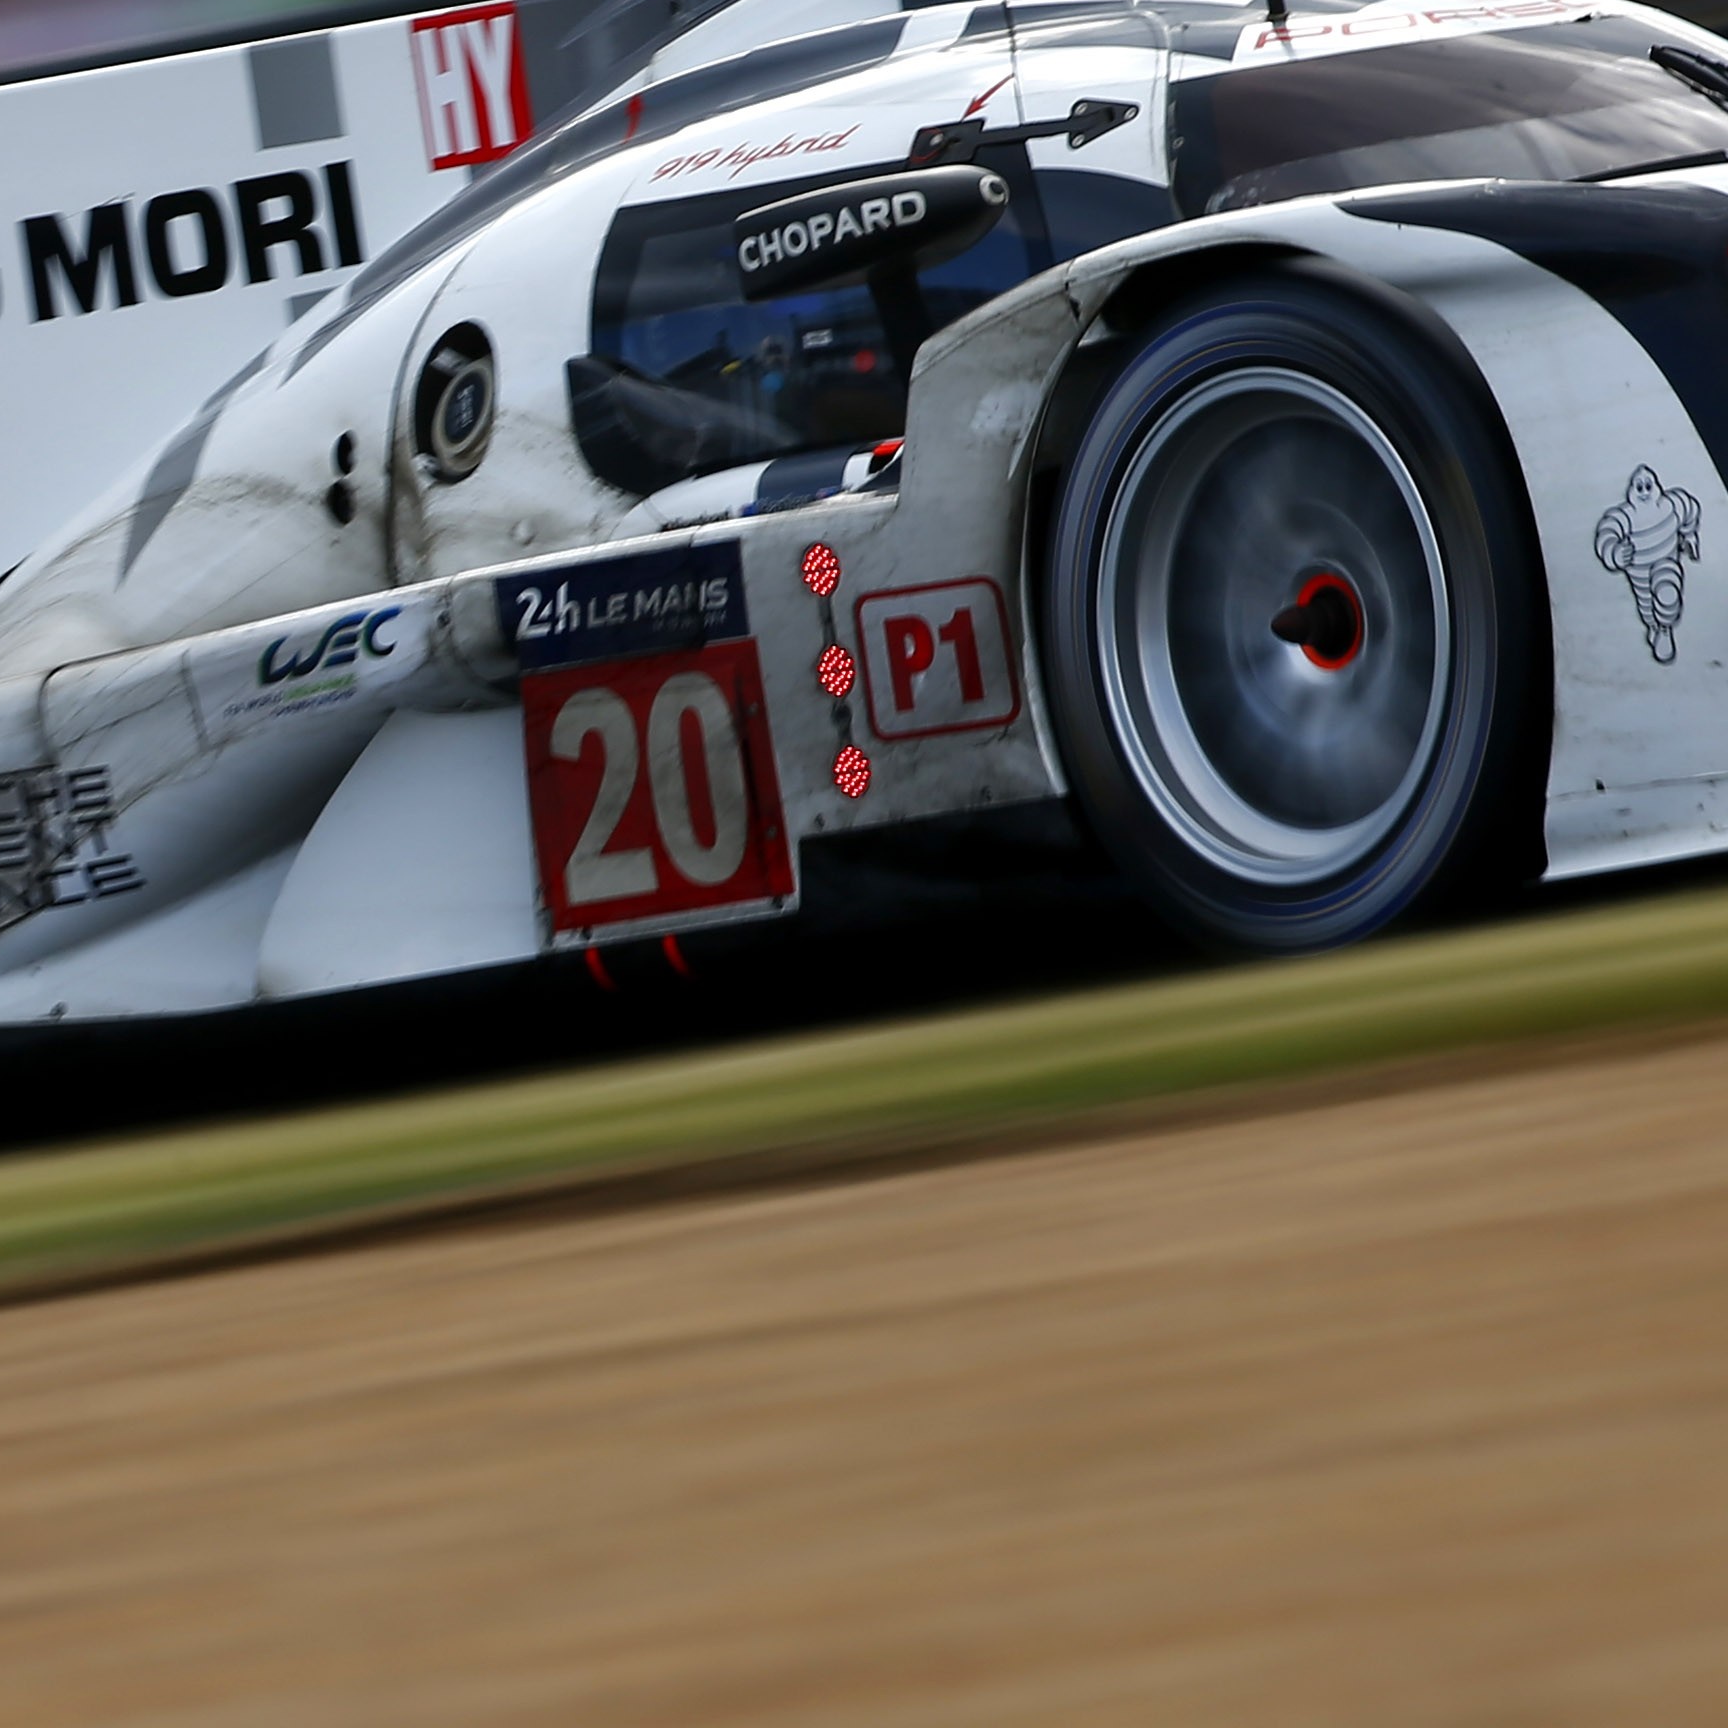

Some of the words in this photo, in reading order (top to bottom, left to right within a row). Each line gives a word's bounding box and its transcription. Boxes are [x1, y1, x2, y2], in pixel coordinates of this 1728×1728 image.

[415, 11, 522, 161] HY
[648, 147, 721, 183] 919
[716, 122, 864, 182] hybrid
[17, 159, 366, 322] MORI
[738, 190, 927, 273] CHOPARD
[257, 604, 403, 687] WEC
[586, 591, 627, 630] LE
[633, 576, 729, 622] MANS
[883, 606, 985, 713] P1
[550, 673, 749, 906] 20
